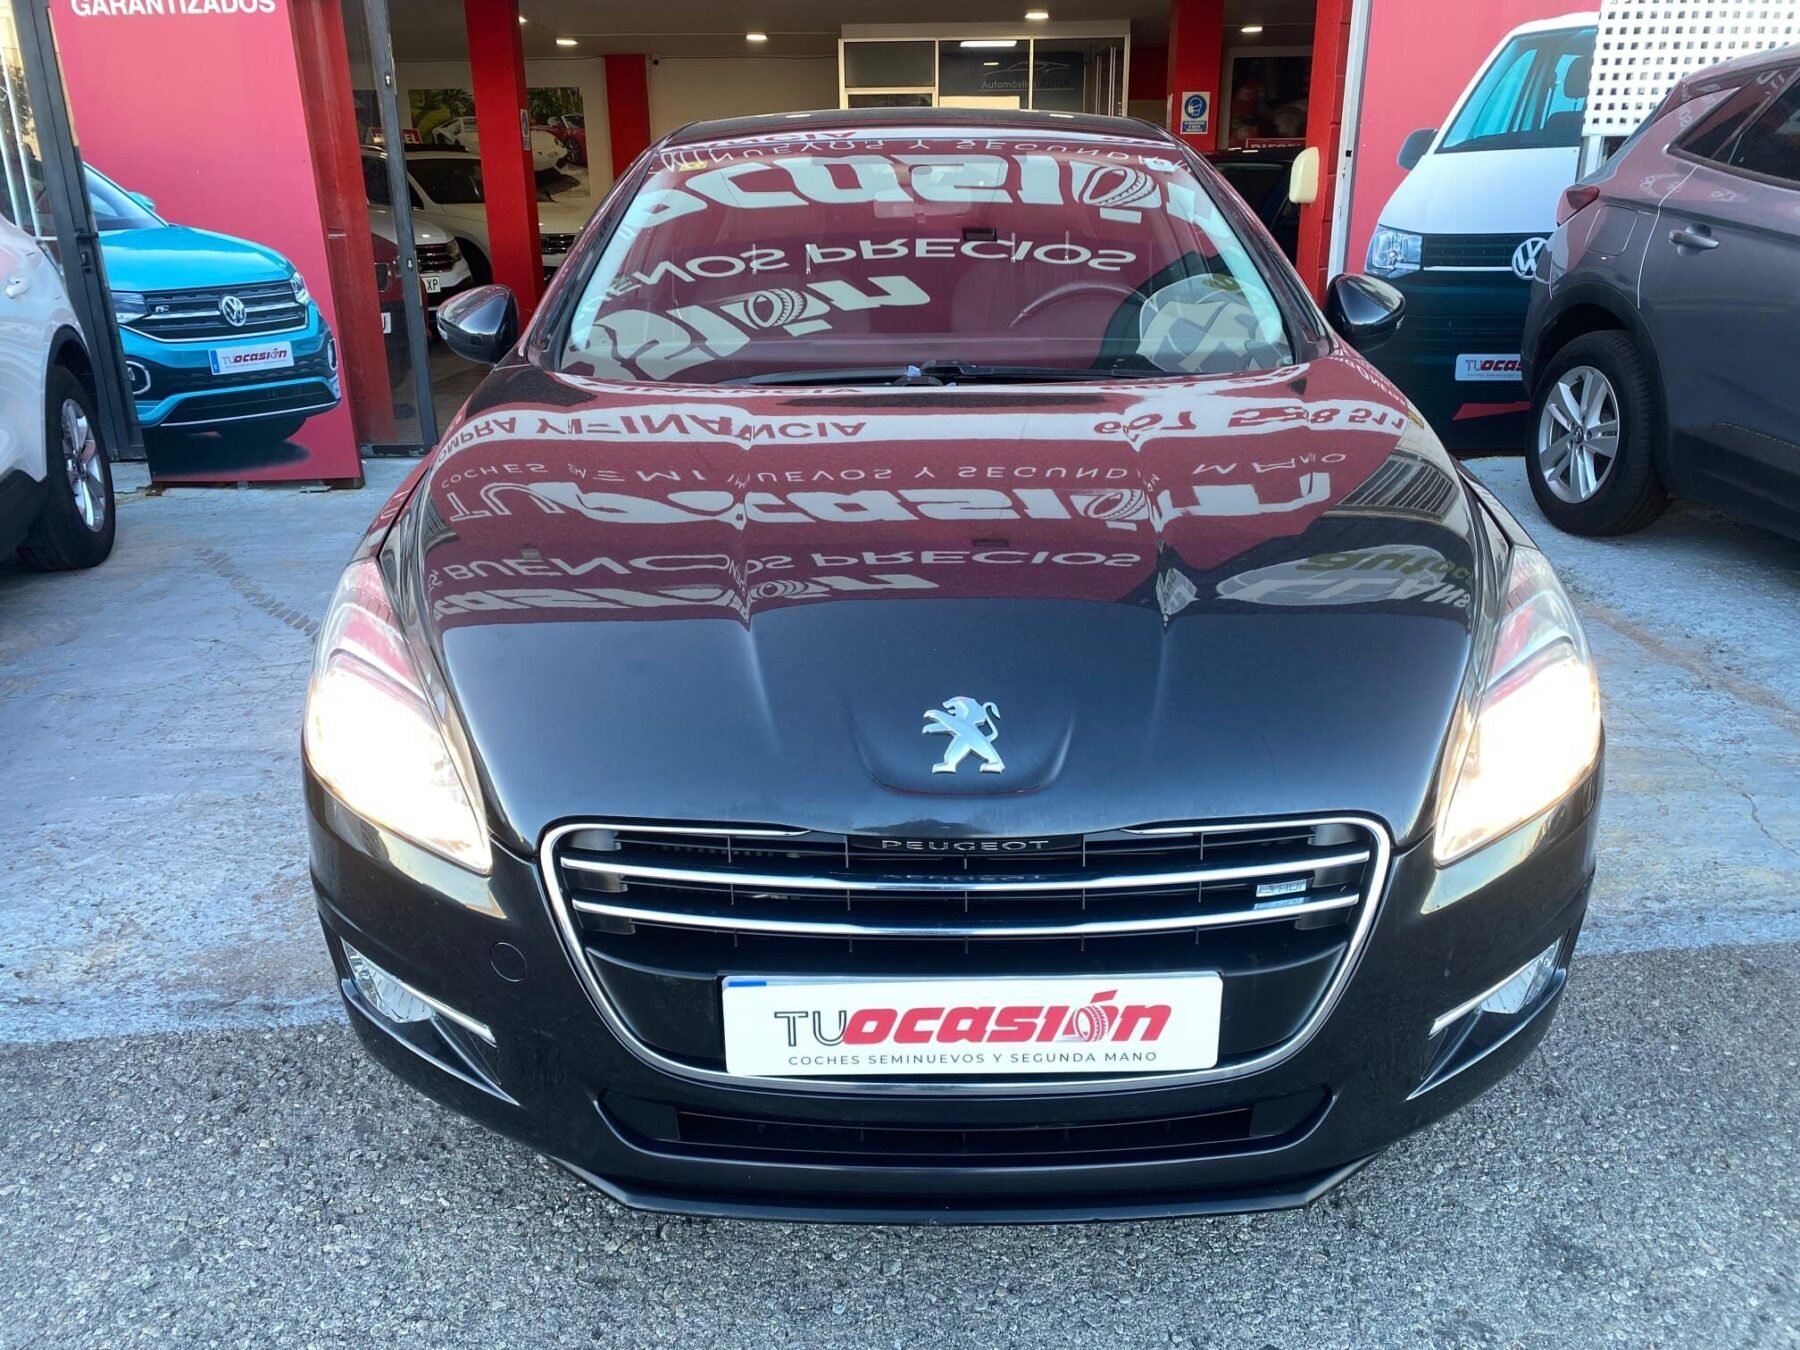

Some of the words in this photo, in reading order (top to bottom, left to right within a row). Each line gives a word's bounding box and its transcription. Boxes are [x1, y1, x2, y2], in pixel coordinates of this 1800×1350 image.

[71, 0, 275, 16] GARANTIZADOS
[881, 840, 1049, 851] PEUGEOT
[789, 1055, 860, 1066] COCHES
[868, 1053, 985, 1065] SEMINUEVOS
[993, 1053, 1003, 1064] Y
[1010, 1052, 1097, 1064] SEGUNDA
[1104, 1051, 1157, 1063] MANO
